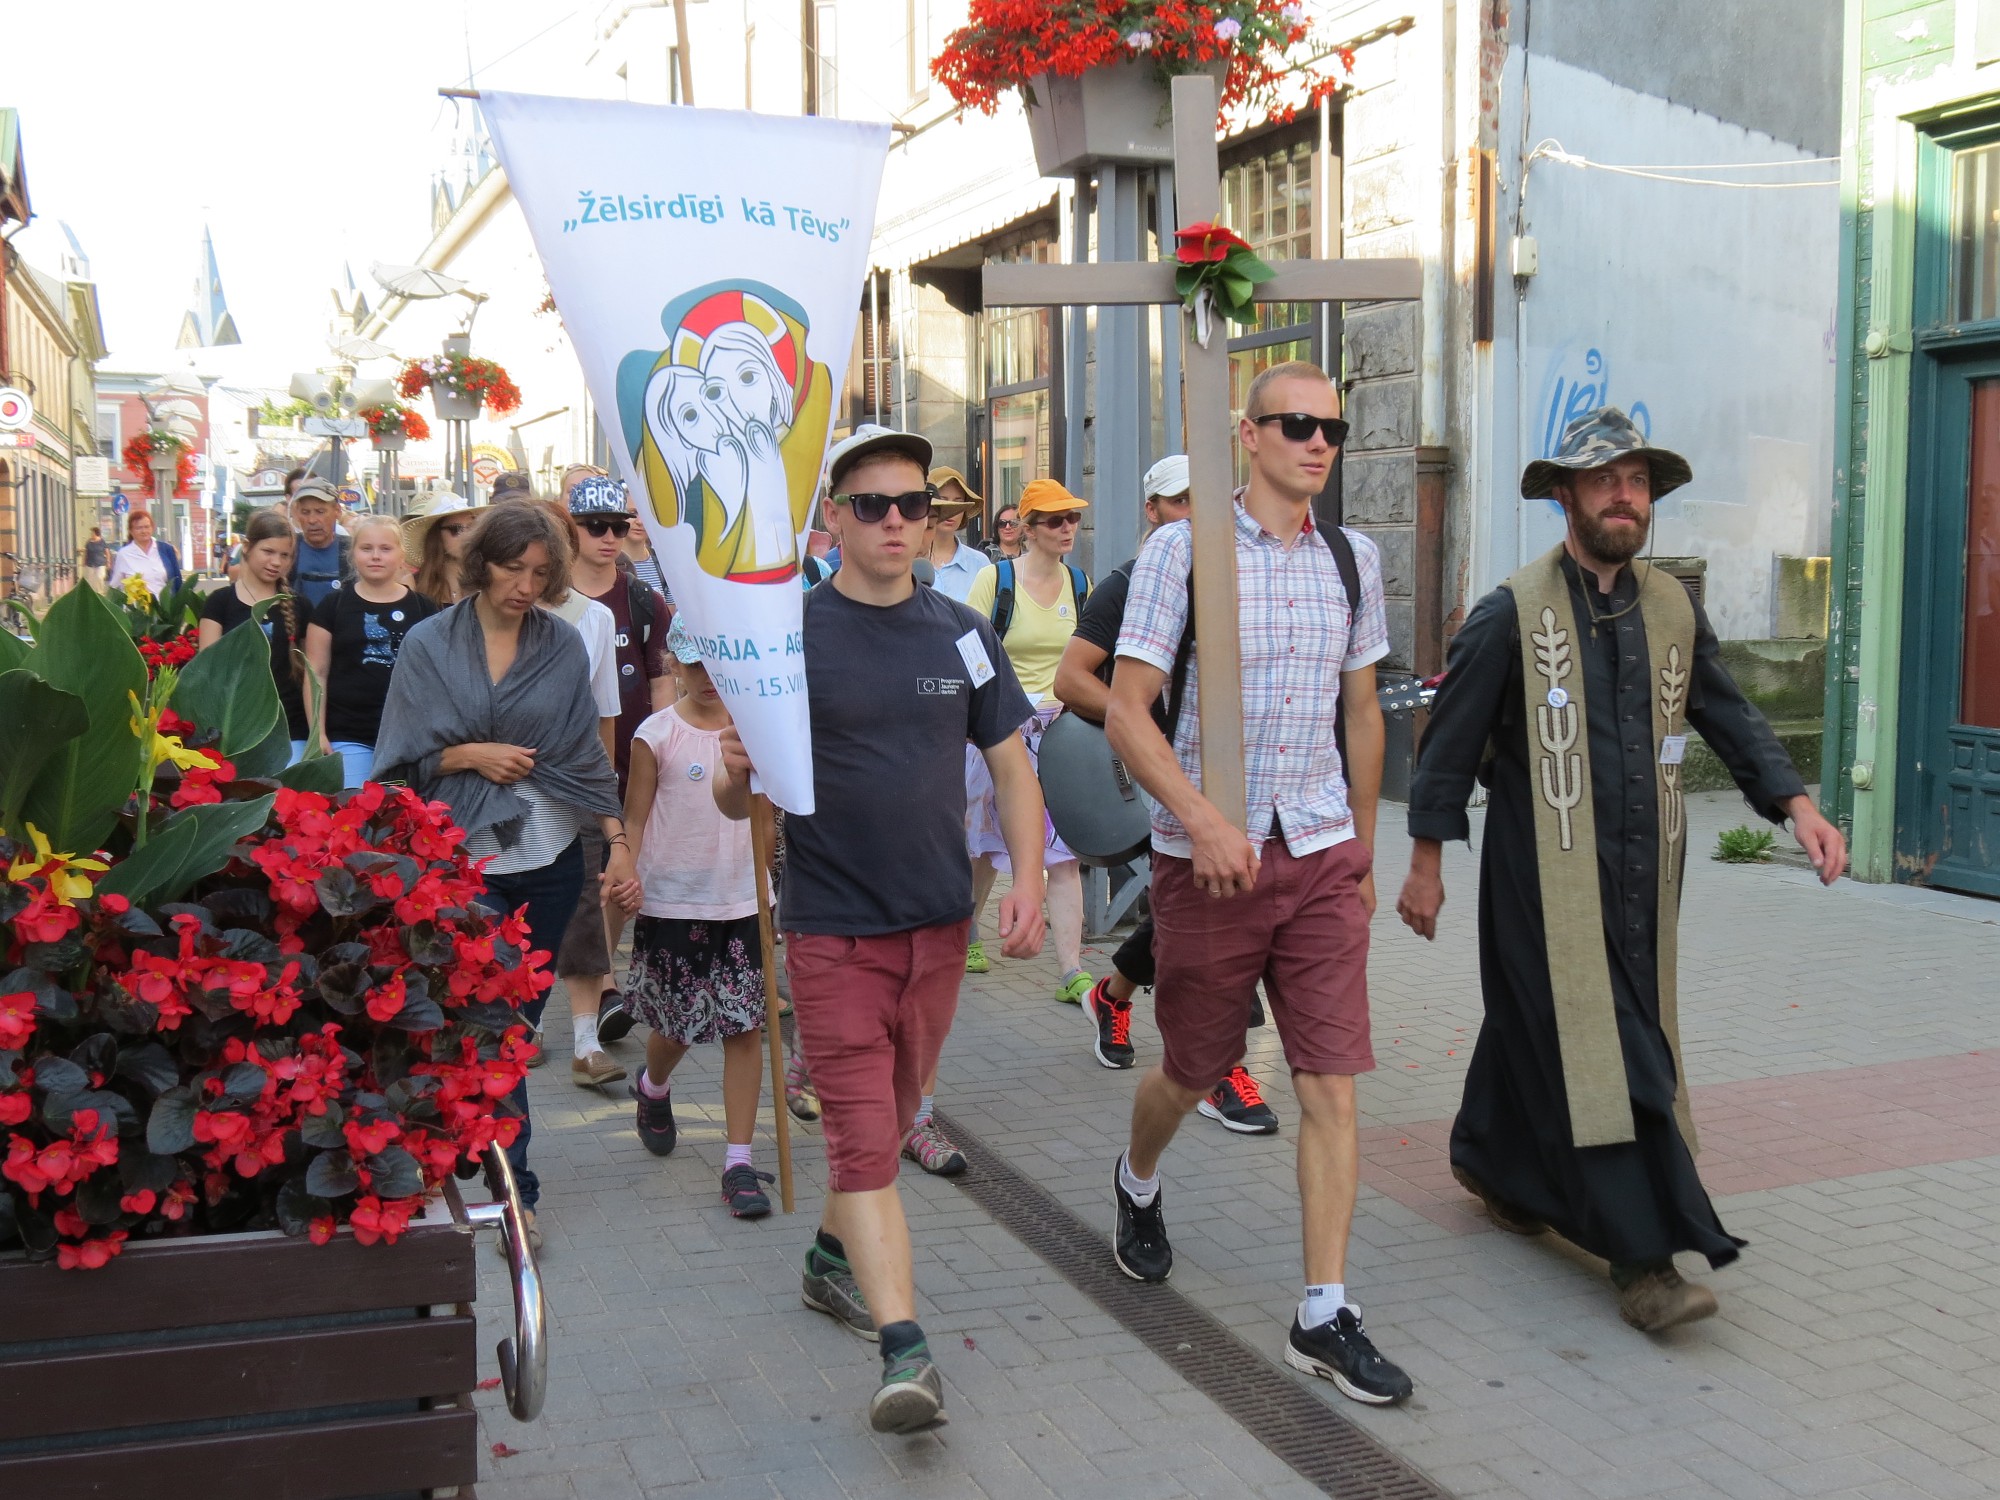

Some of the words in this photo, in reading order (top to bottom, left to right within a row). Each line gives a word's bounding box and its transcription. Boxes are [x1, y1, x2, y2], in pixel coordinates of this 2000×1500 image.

[563, 190, 724, 233] „Žēlsirdīgi
[740, 197, 776, 226] kā
[783, 205, 850, 243] Tēvs”
[693, 634, 760, 661] LIEPĀJA
